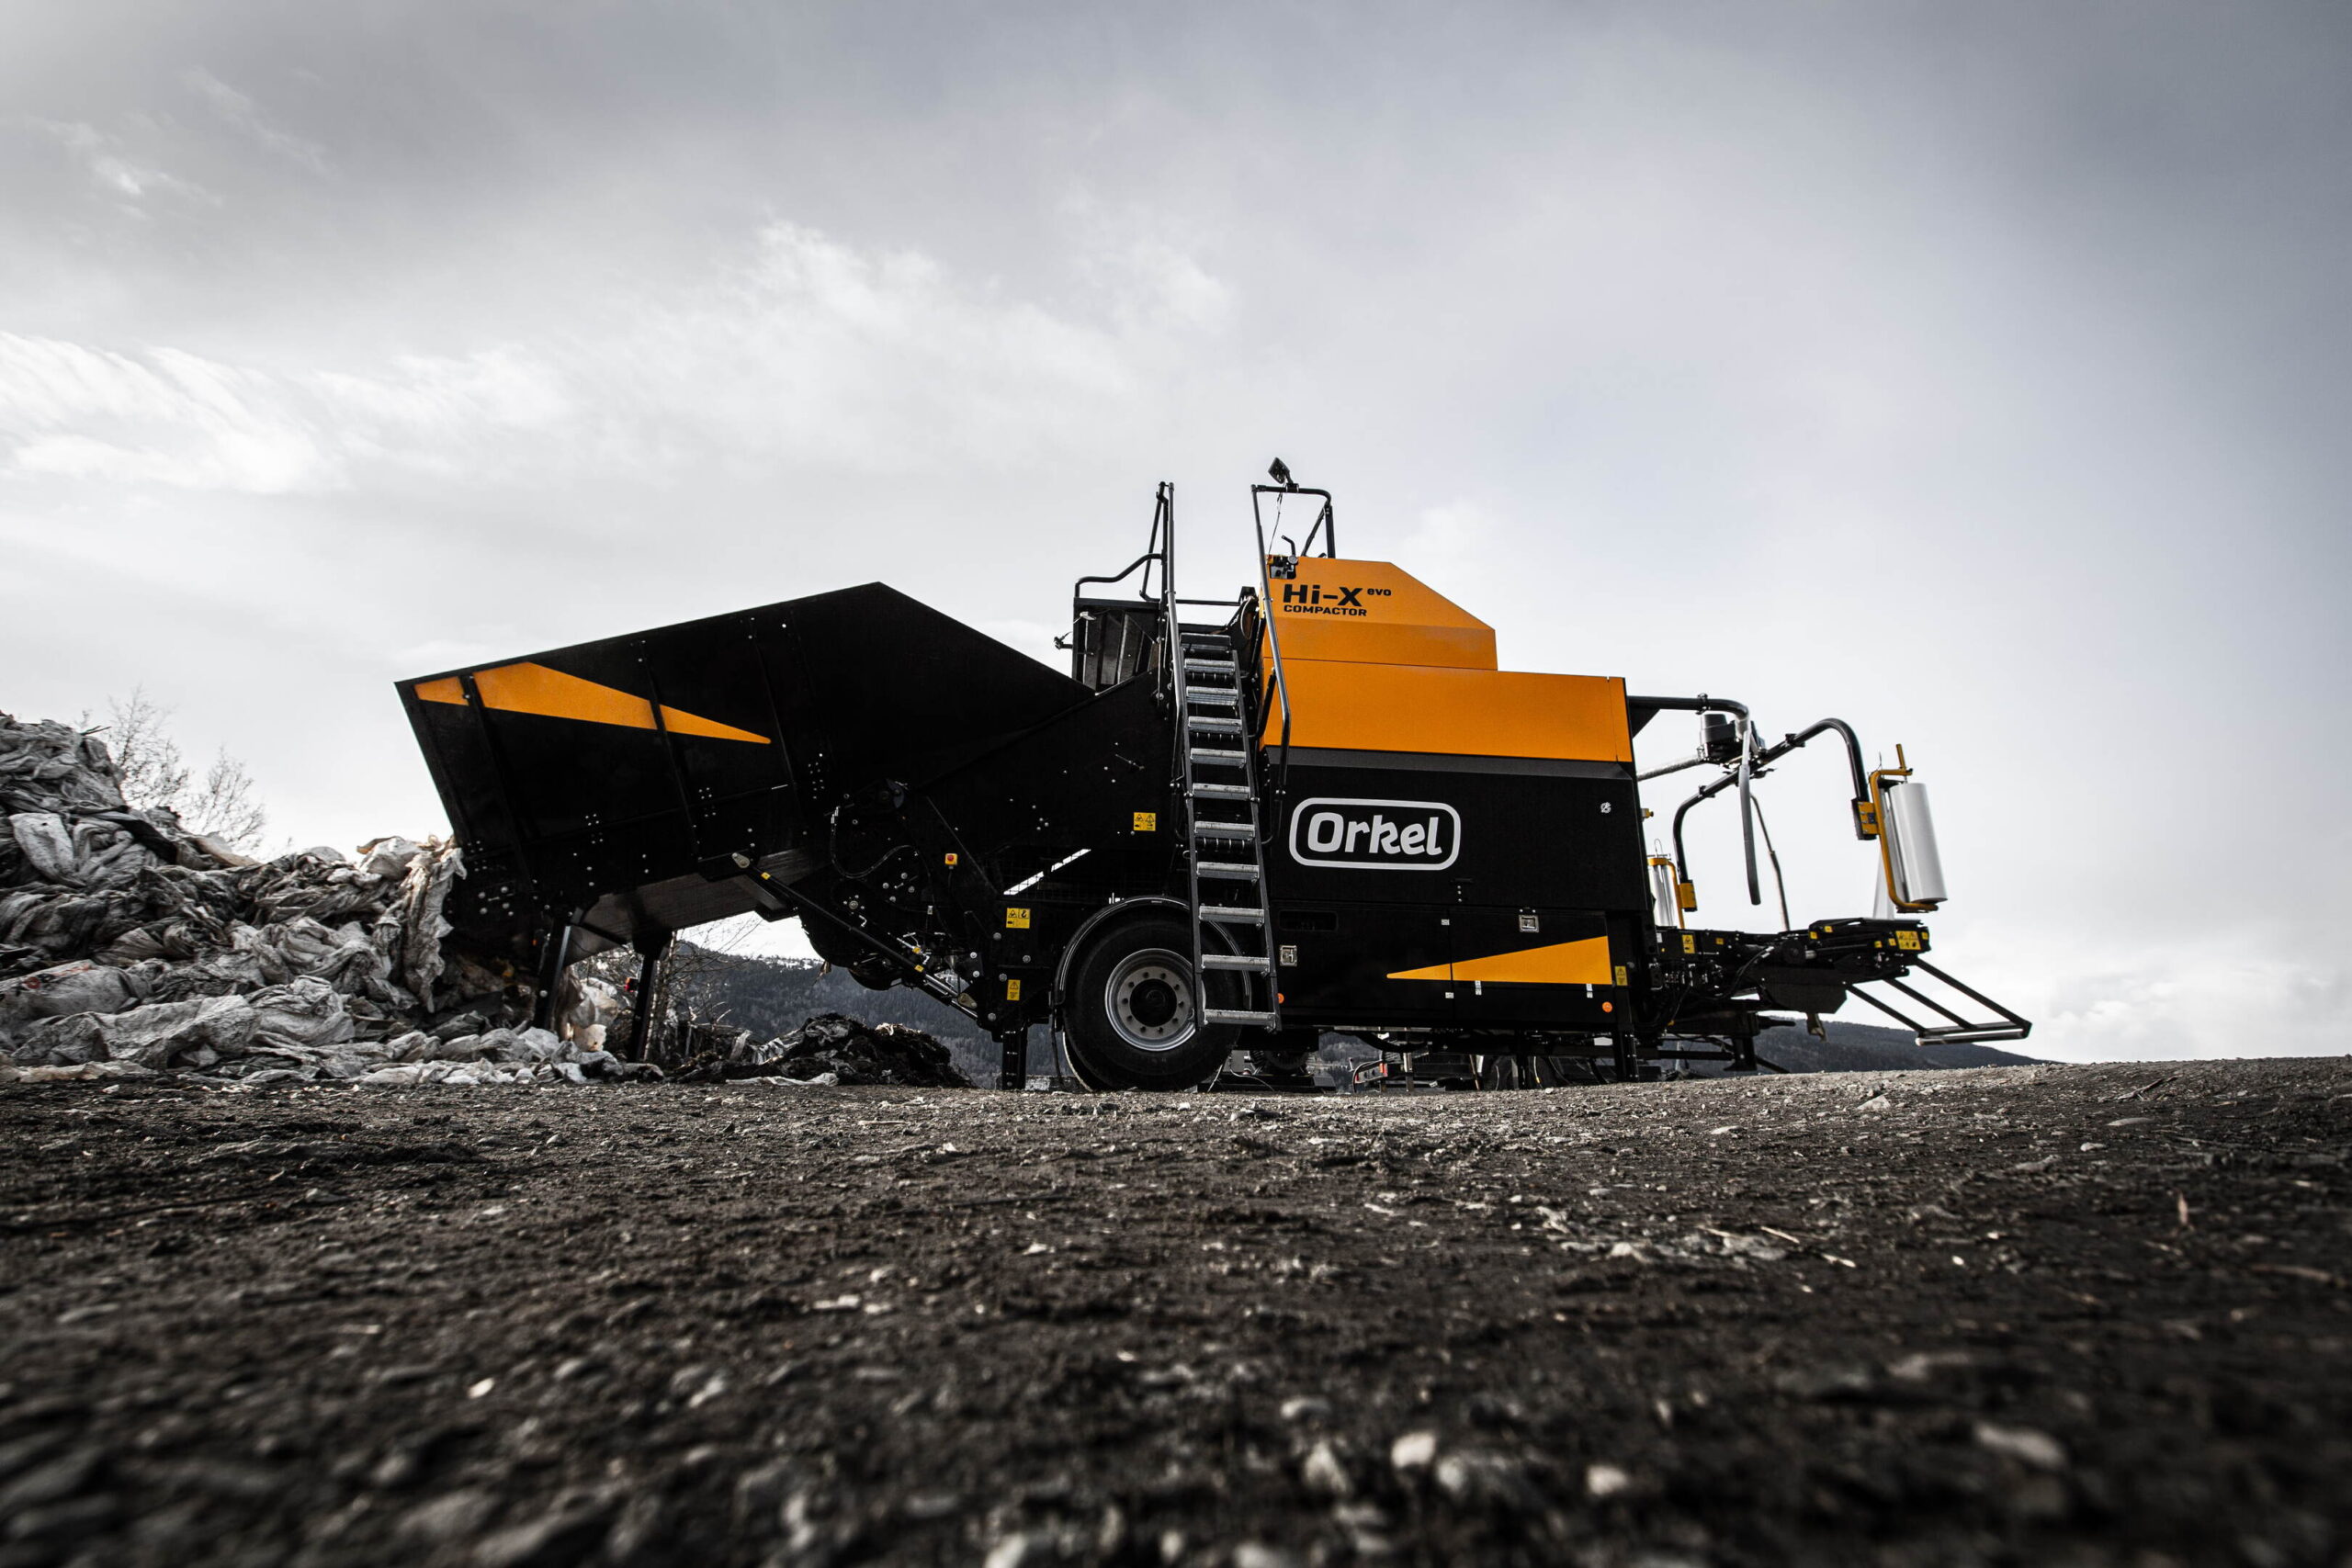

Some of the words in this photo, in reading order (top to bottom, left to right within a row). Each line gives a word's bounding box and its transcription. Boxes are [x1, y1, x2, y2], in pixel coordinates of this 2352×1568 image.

[1283, 583, 1363, 607] Hi-X
[1366, 588, 1392, 596] evo
[1283, 604, 1367, 616] COMPACTOR
[1307, 812, 1442, 855] Orkel
